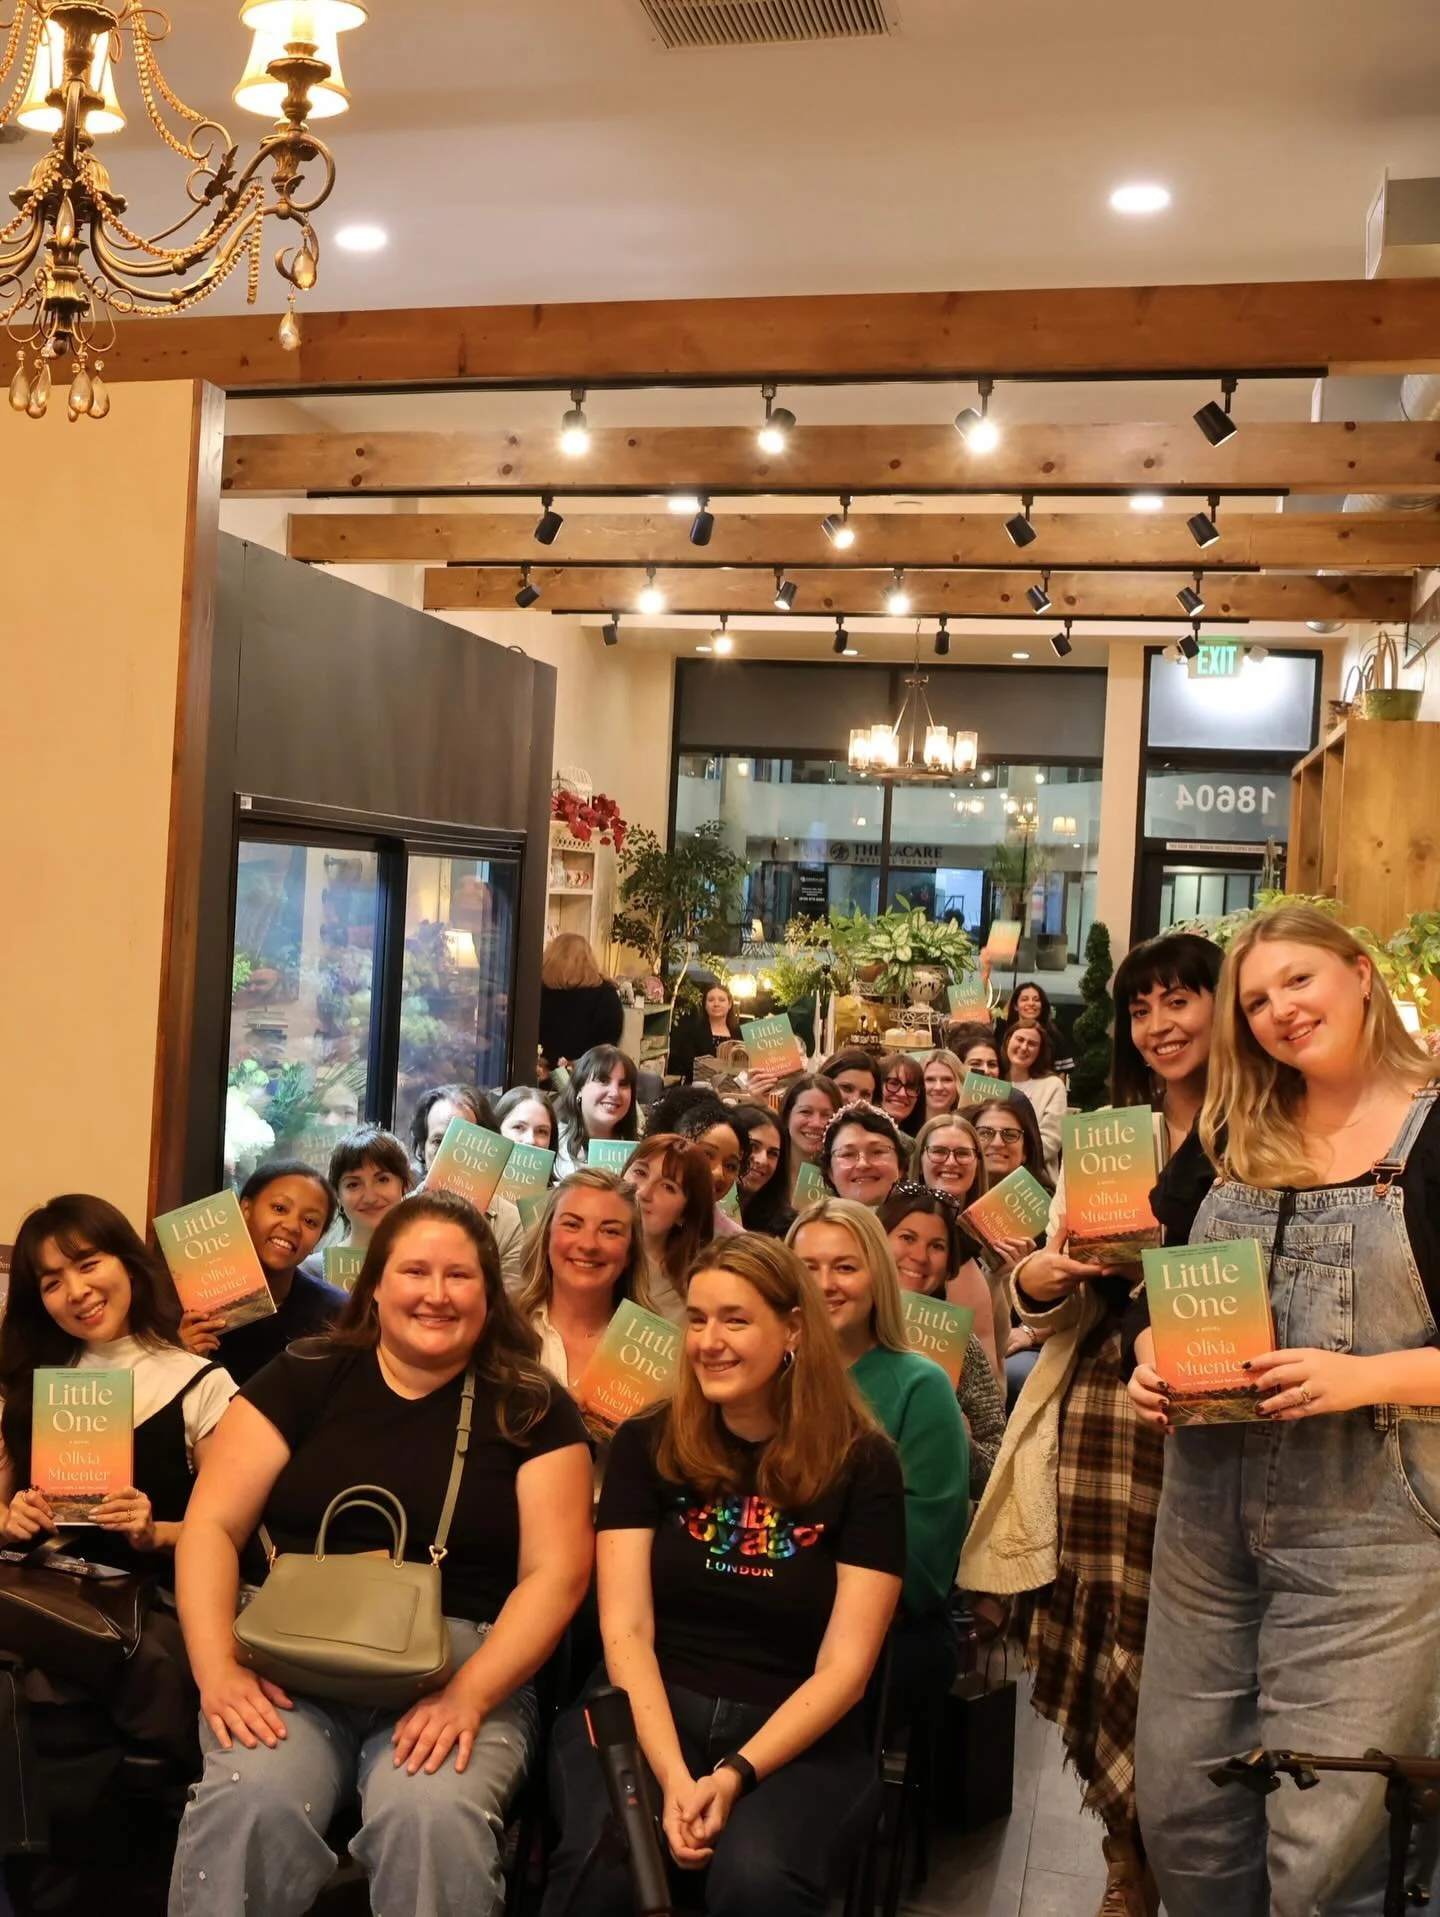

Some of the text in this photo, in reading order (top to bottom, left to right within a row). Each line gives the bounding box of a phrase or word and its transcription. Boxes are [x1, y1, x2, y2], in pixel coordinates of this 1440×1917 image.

[1197, 644, 1238, 675] EXIT
[757, 1036, 784, 1050] One
[972, 1079, 1003, 1097] Little
[455, 1128, 499, 1158] Little
[1074, 1119, 1136, 1150] Little
[452, 1148, 489, 1173] One
[1080, 1152, 1133, 1176] One
[1004, 1192, 1032, 1225] One
[1014, 1179, 1047, 1217] Little
[1088, 1190, 1129, 1208] Olivia
[172, 1208, 229, 1242] Little
[1080, 1207, 1140, 1225] Muenter
[184, 1232, 232, 1260] One
[196, 1273, 248, 1299] Muenter
[201, 1264, 237, 1285] Olivia
[1161, 1256, 1240, 1290] Little
[904, 1303, 958, 1333] Little
[1172, 1293, 1239, 1320] One
[905, 1326, 949, 1352] One
[1186, 1339, 1236, 1357] Olivia
[620, 1343, 668, 1381] One
[48, 1380, 113, 1406] Little
[52, 1409, 108, 1432] One
[58, 1450, 101, 1465] Olivia
[48, 1467, 111, 1481] Muenter
[705, 1558, 774, 1577] LONDON
